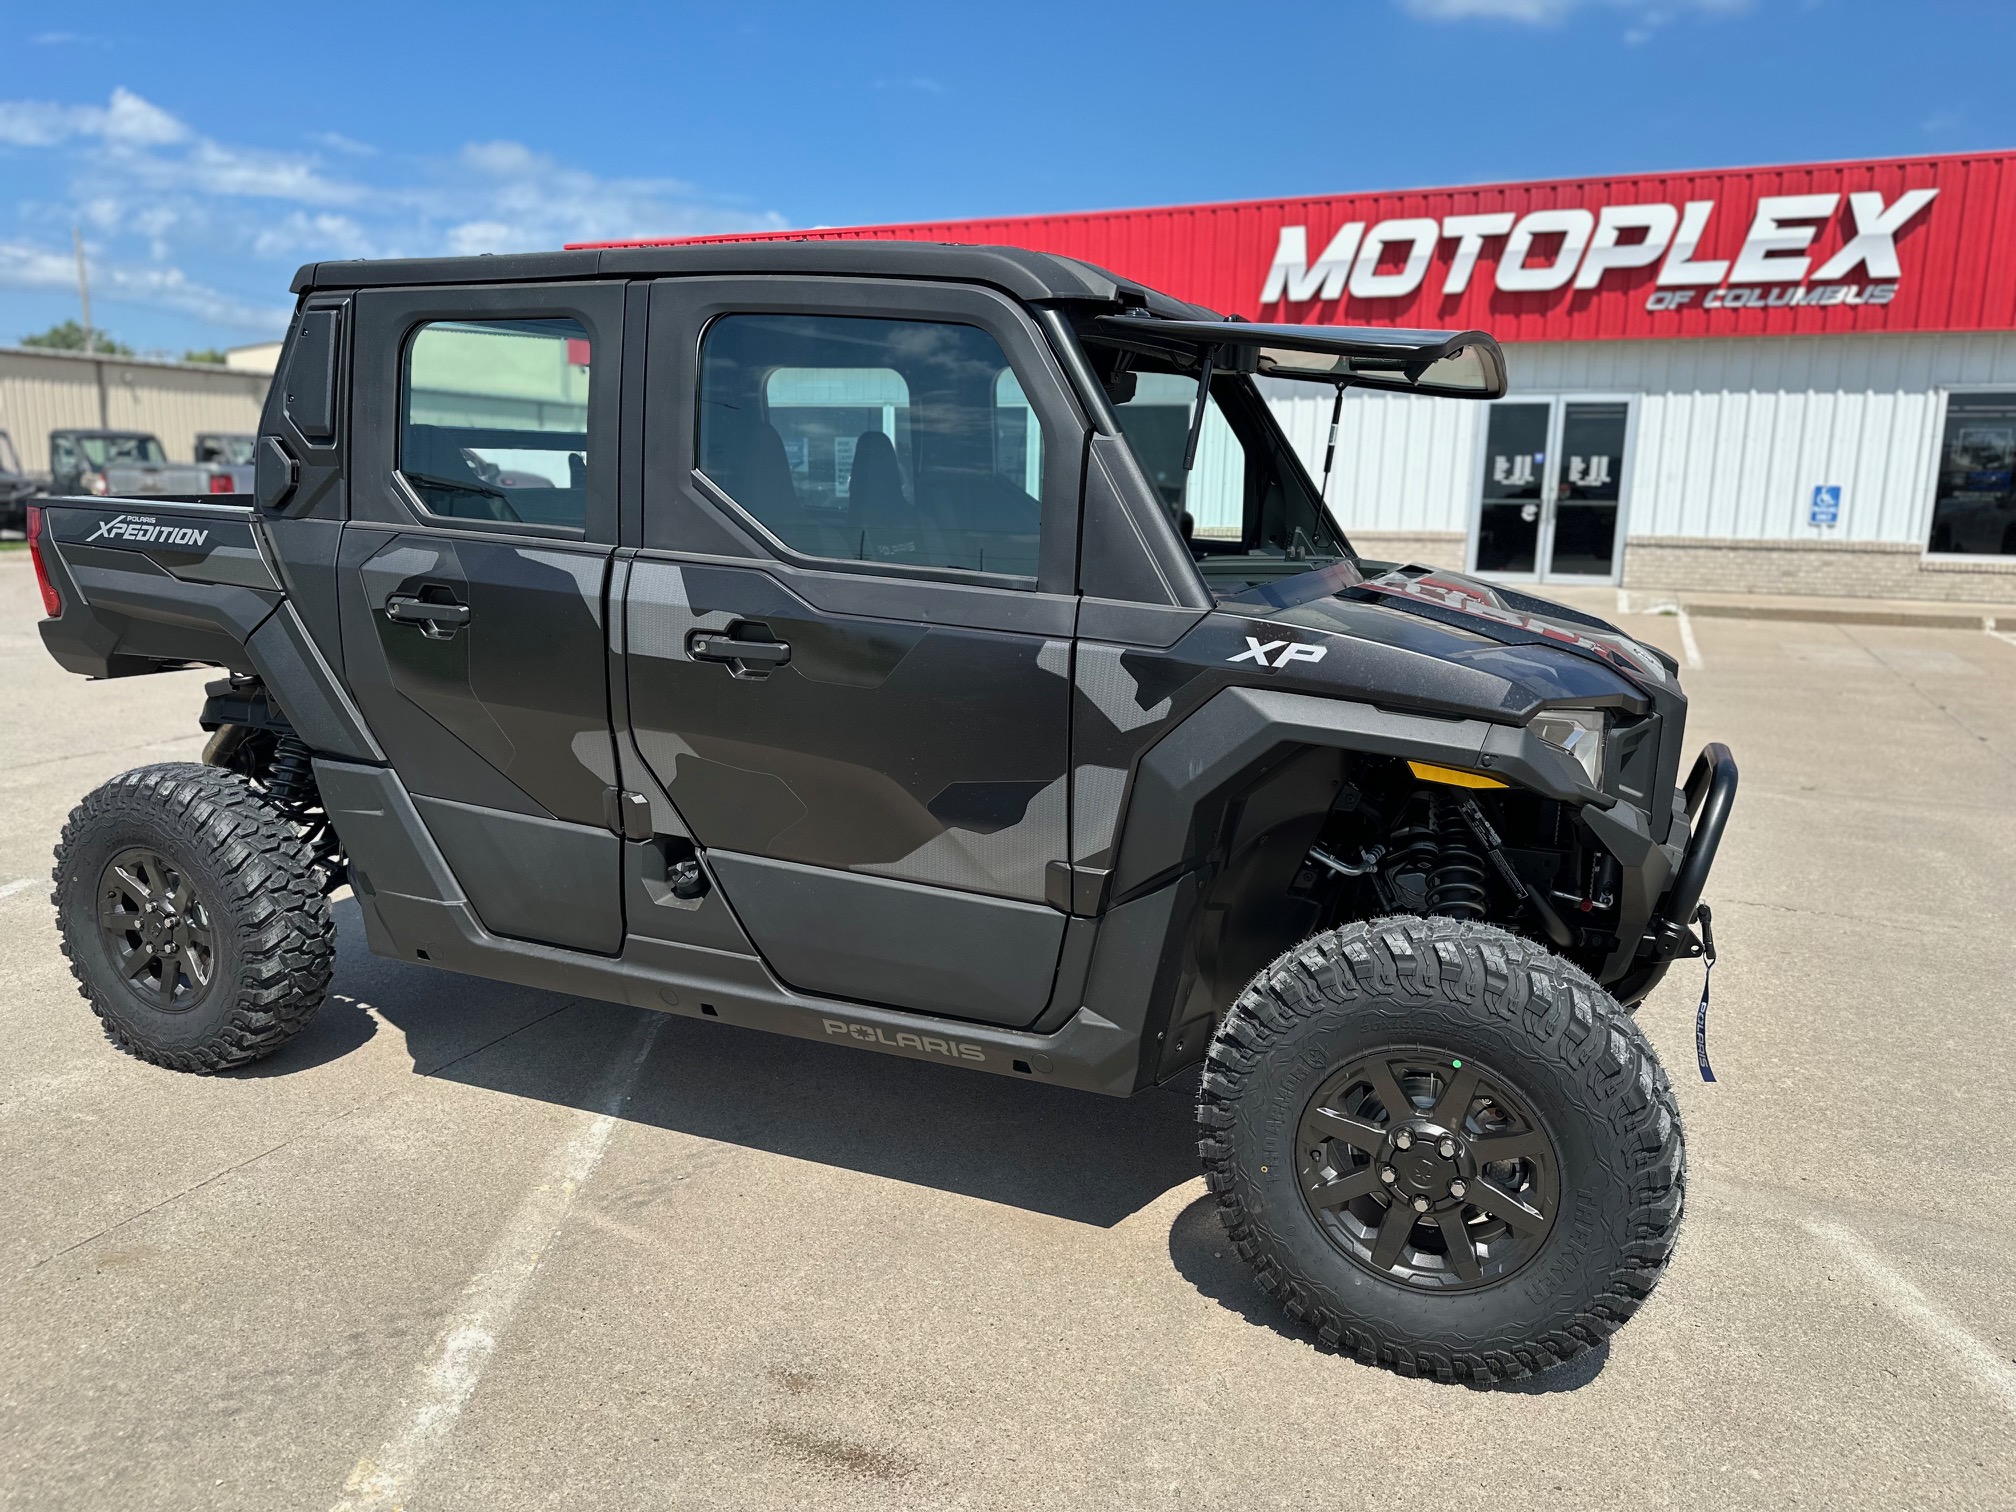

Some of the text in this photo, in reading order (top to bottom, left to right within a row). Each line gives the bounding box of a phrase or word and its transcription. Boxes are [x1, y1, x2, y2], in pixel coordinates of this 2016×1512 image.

[1260, 188, 1940, 304] MOTOPLEX
[1645, 284, 1898, 310] OF COLUMBUS
[85, 514, 209, 546] XPEDITION
[126, 515, 156, 524] POLARIS
[1225, 636, 1328, 668] XP
[821, 1018, 986, 1062] POLARIS
[1696, 1001, 1709, 1068] POLARIS
